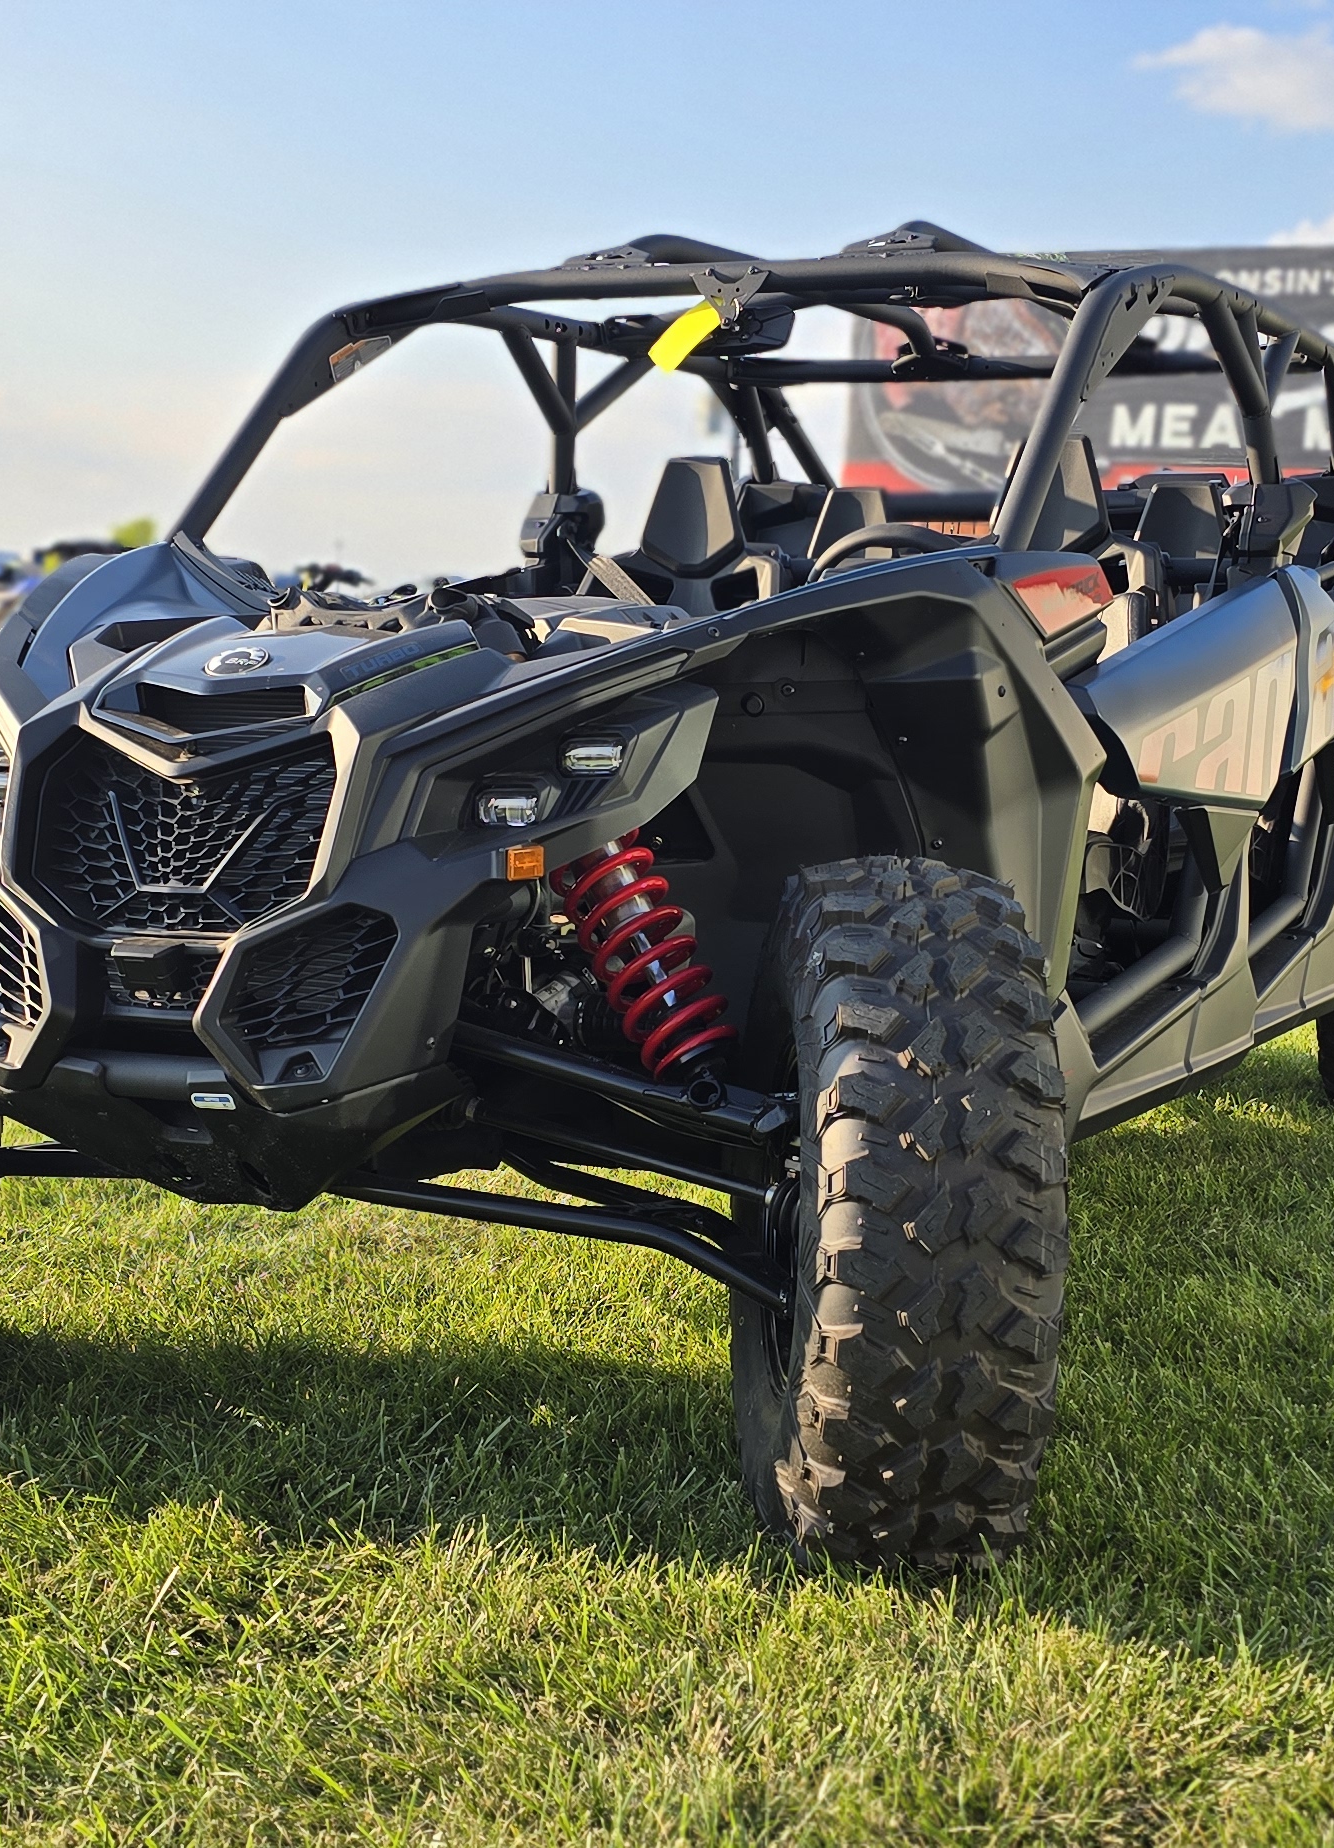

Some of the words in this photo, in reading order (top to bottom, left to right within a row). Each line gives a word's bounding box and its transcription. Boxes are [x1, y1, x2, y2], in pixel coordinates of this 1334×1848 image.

[1110, 403, 1244, 449] MEA
[224, 657, 259, 666] BRP
[345, 643, 421, 678] TURBO
